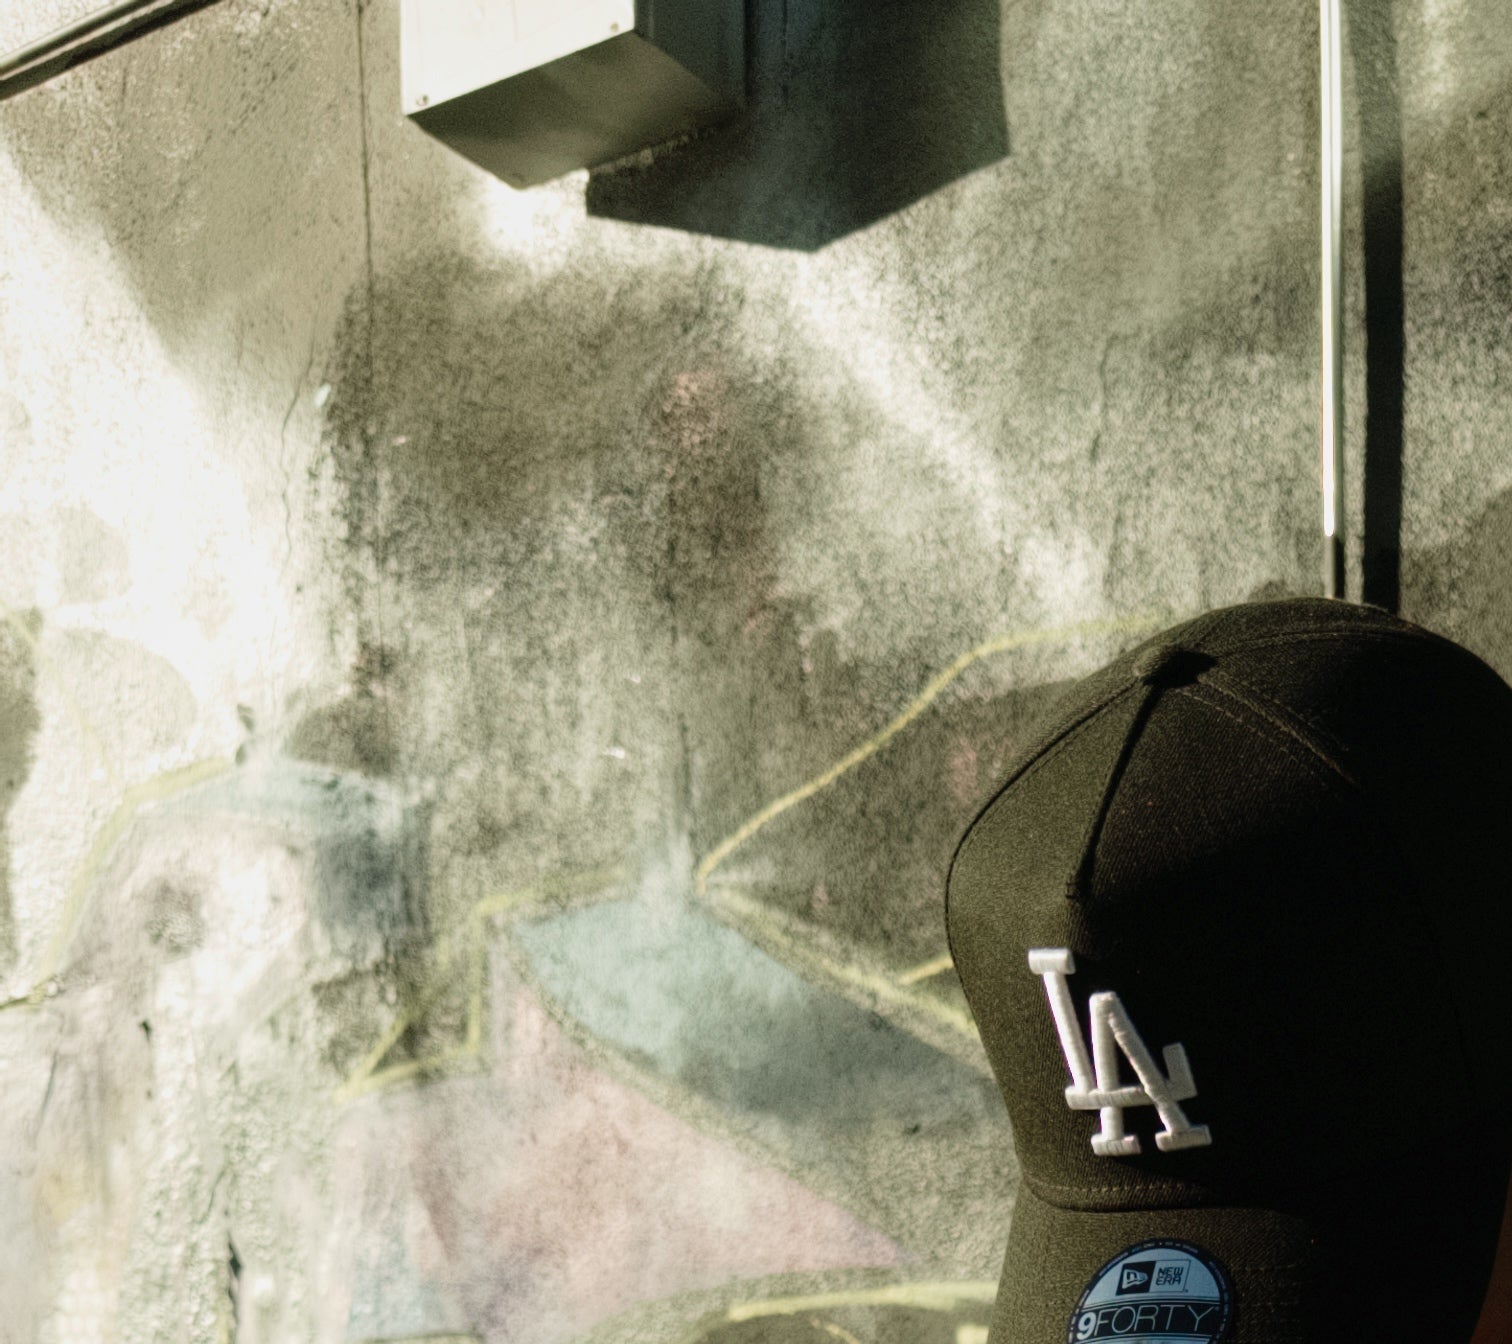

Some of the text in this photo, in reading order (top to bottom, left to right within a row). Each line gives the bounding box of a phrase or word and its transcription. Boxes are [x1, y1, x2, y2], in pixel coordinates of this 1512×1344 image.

[1028, 947, 1212, 1156] LA
[1155, 1275, 1182, 1286] ERA
[1158, 1266, 1184, 1276] NEW
[1076, 1304, 1214, 1340] 9FORTY
